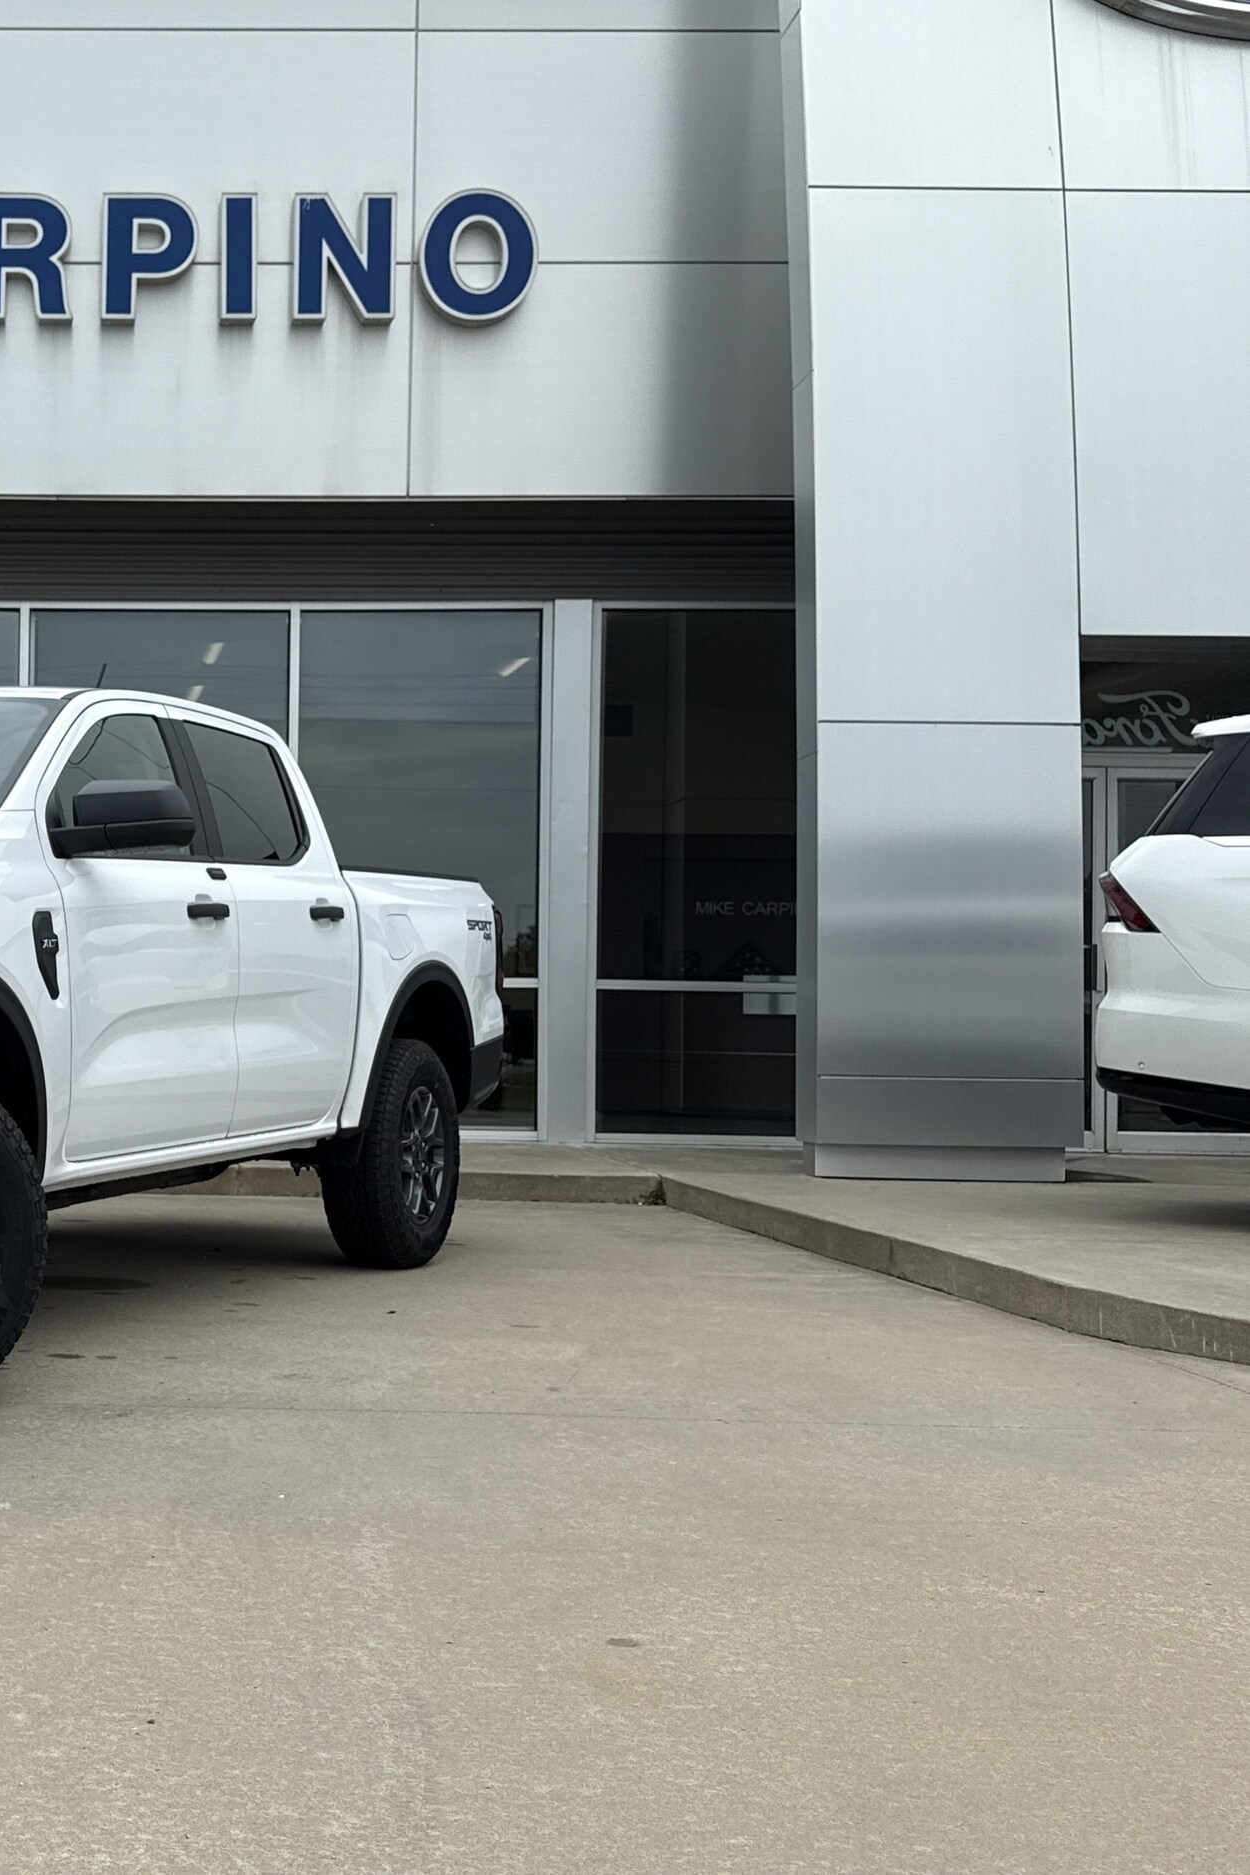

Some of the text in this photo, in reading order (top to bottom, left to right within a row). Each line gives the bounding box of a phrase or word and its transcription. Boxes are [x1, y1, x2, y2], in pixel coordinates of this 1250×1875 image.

[695, 901, 797, 915] MIKE CARPI
[466, 919, 492, 931] SPORT
